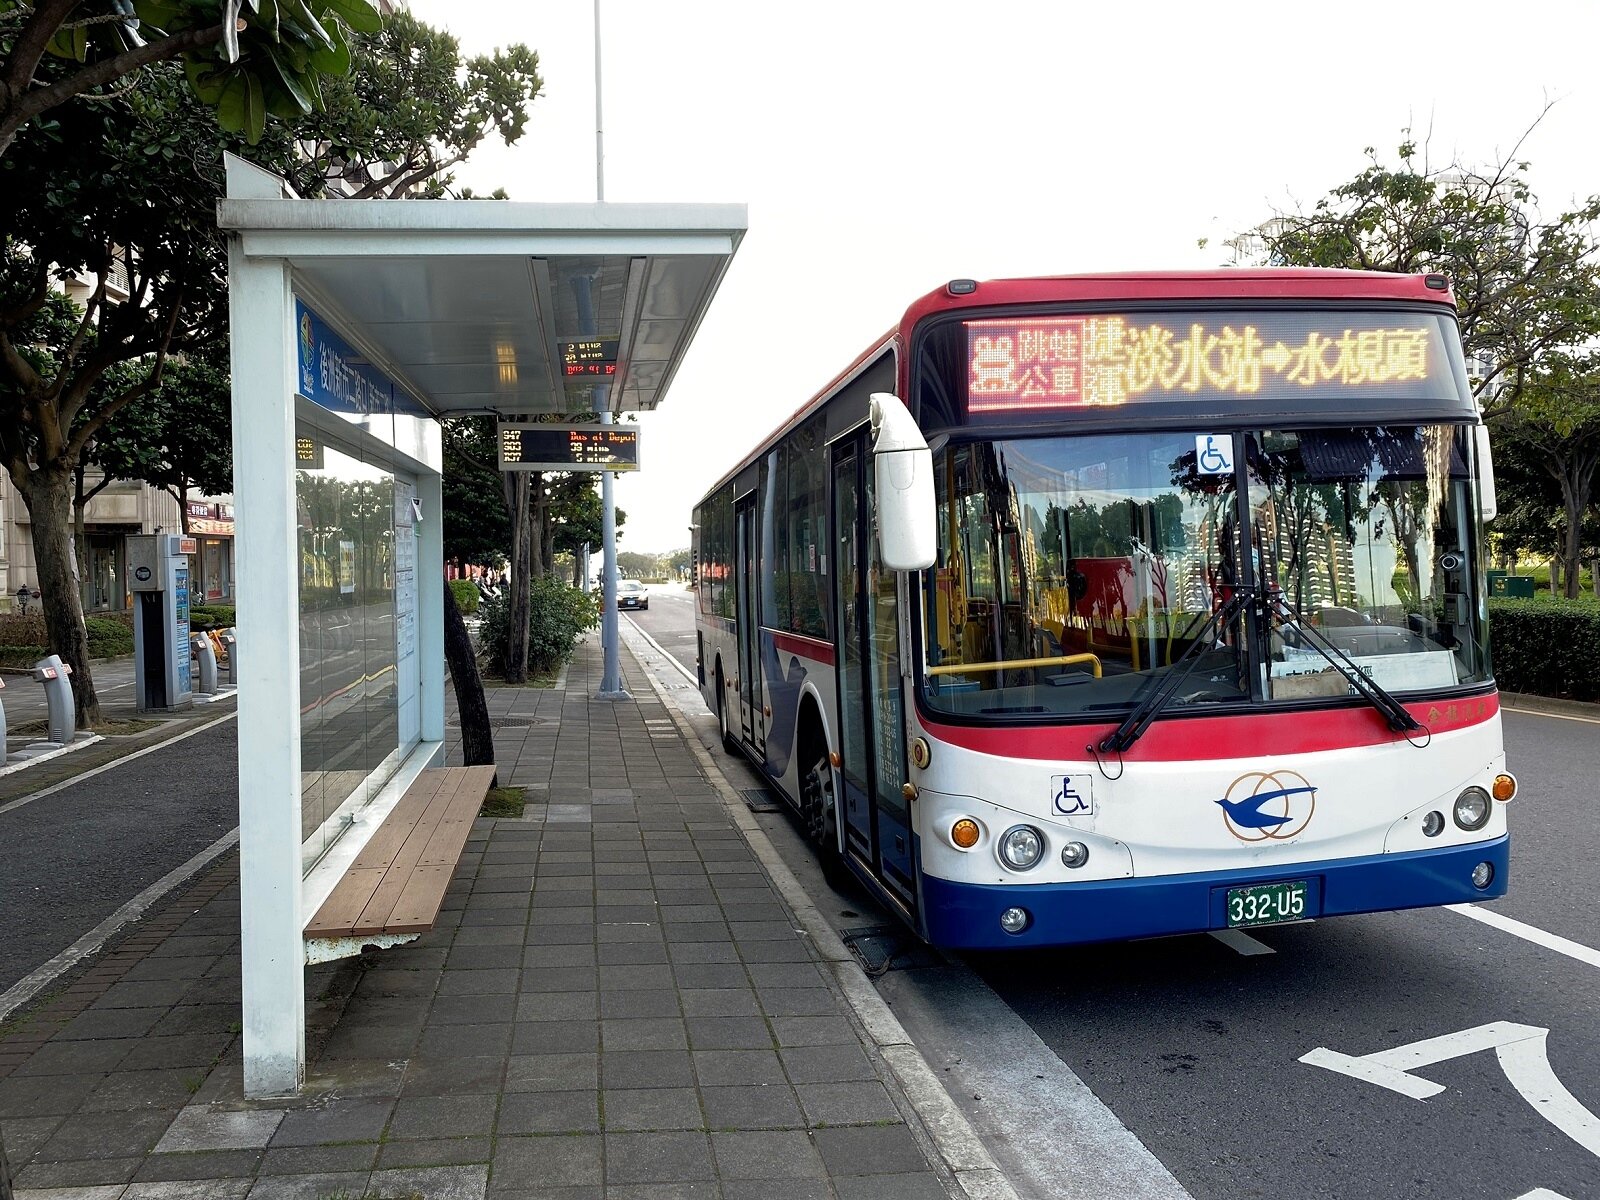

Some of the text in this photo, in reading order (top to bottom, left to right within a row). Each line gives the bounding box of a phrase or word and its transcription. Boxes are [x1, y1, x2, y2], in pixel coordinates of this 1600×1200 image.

[1017, 329, 1080, 362] 跳蛙
[1126, 322, 1263, 393] 淡水站
[1016, 364, 1079, 398] 公車
[569, 431, 588, 441] Bus
[1230, 888, 1304, 921] 332-U5
